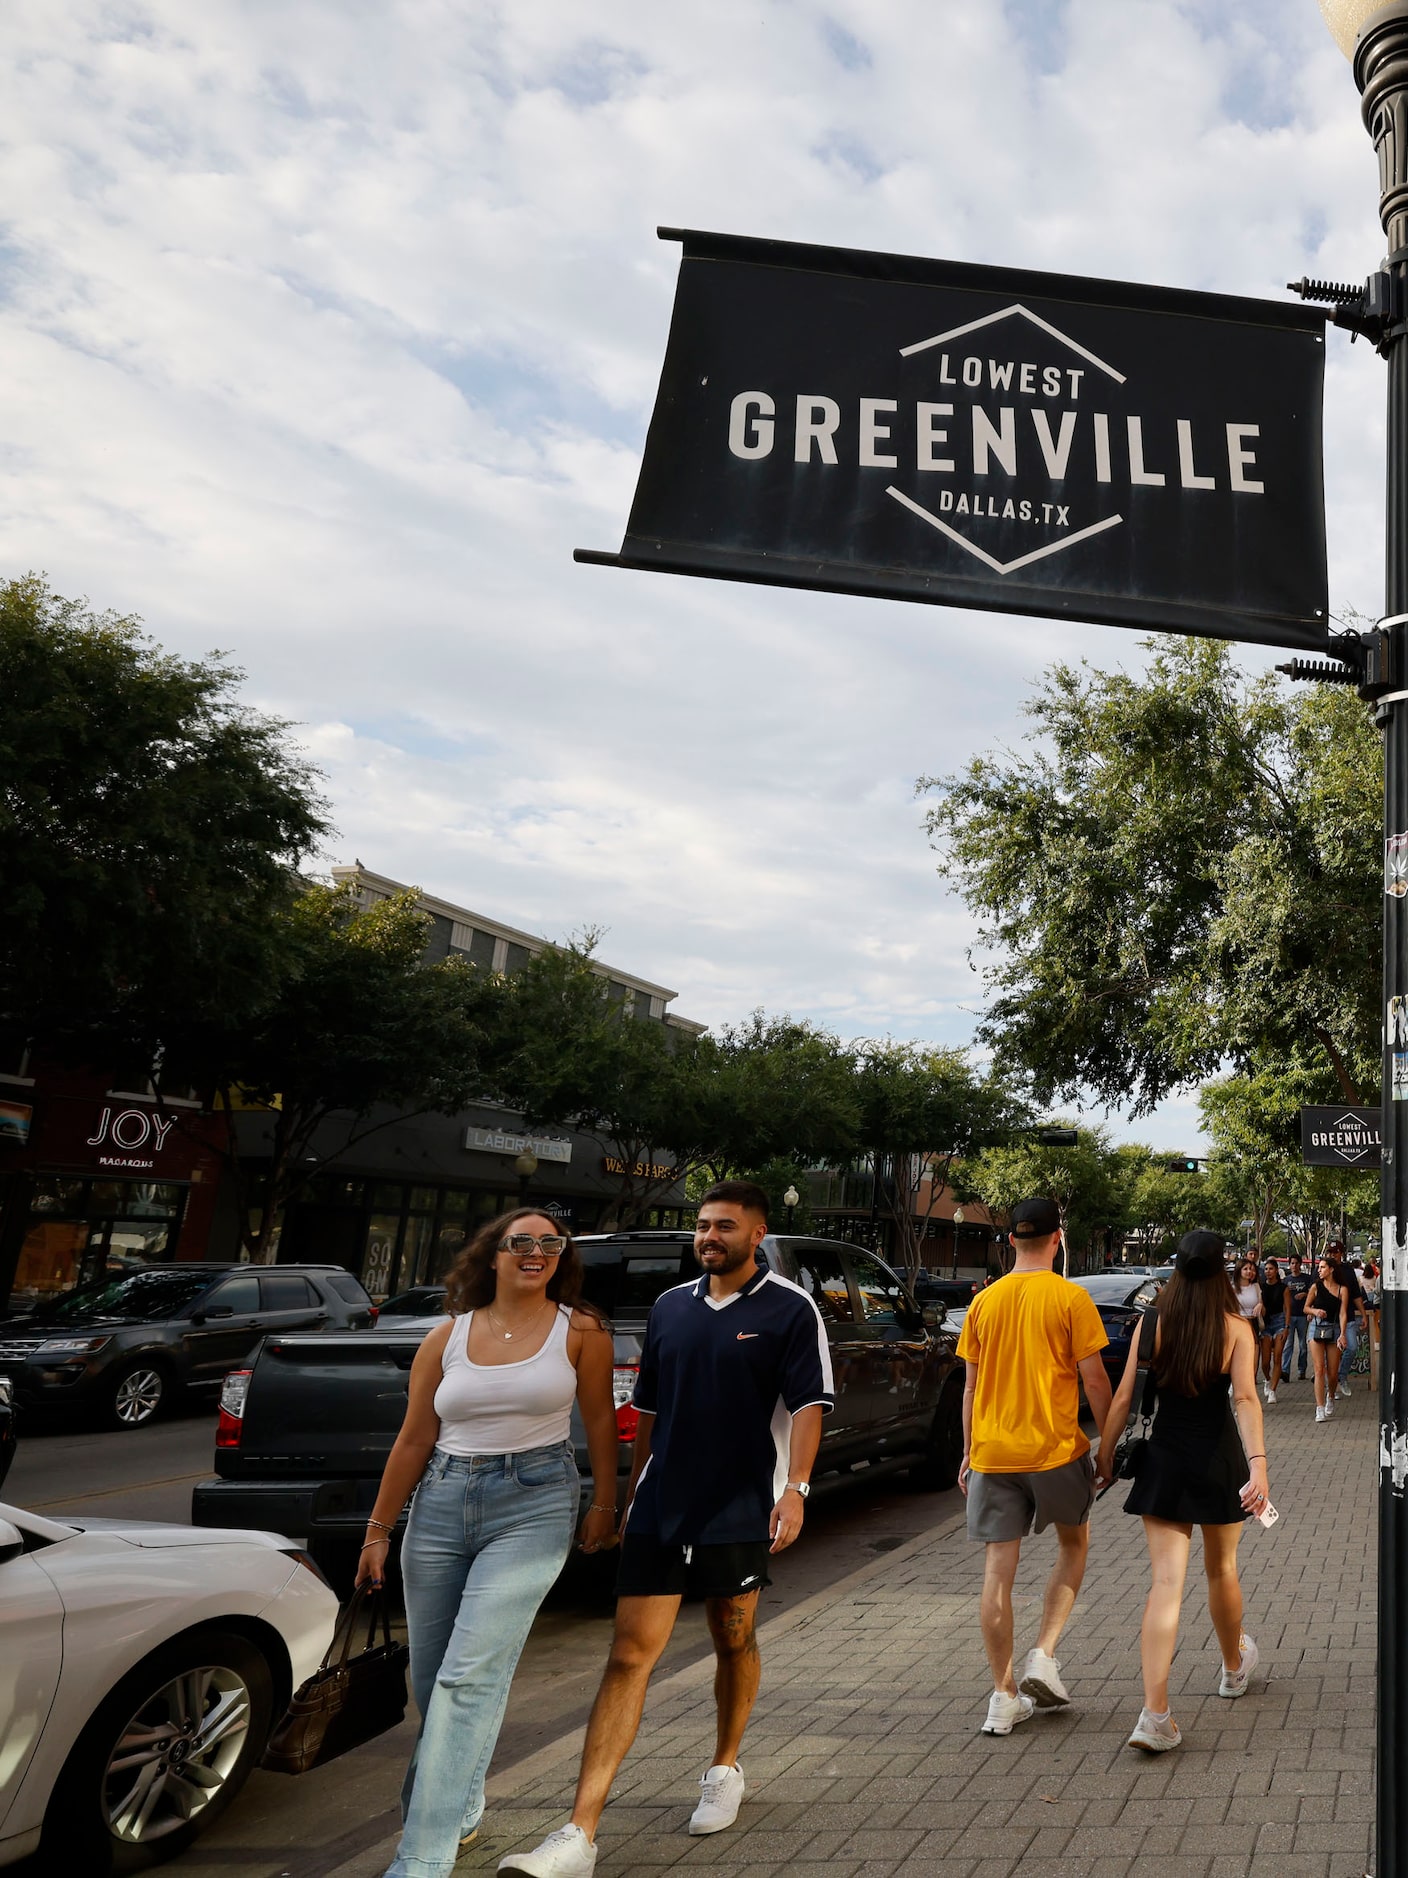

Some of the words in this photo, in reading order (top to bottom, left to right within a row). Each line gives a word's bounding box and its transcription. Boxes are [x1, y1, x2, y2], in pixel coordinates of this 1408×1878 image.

[940, 355, 1085, 398] LOWEST
[728, 391, 1265, 493] GREENVILLE
[939, 490, 1070, 527] DALLAS,TX
[87, 1107, 178, 1151] JOY
[1311, 1131, 1382, 1146] GREENVILL
